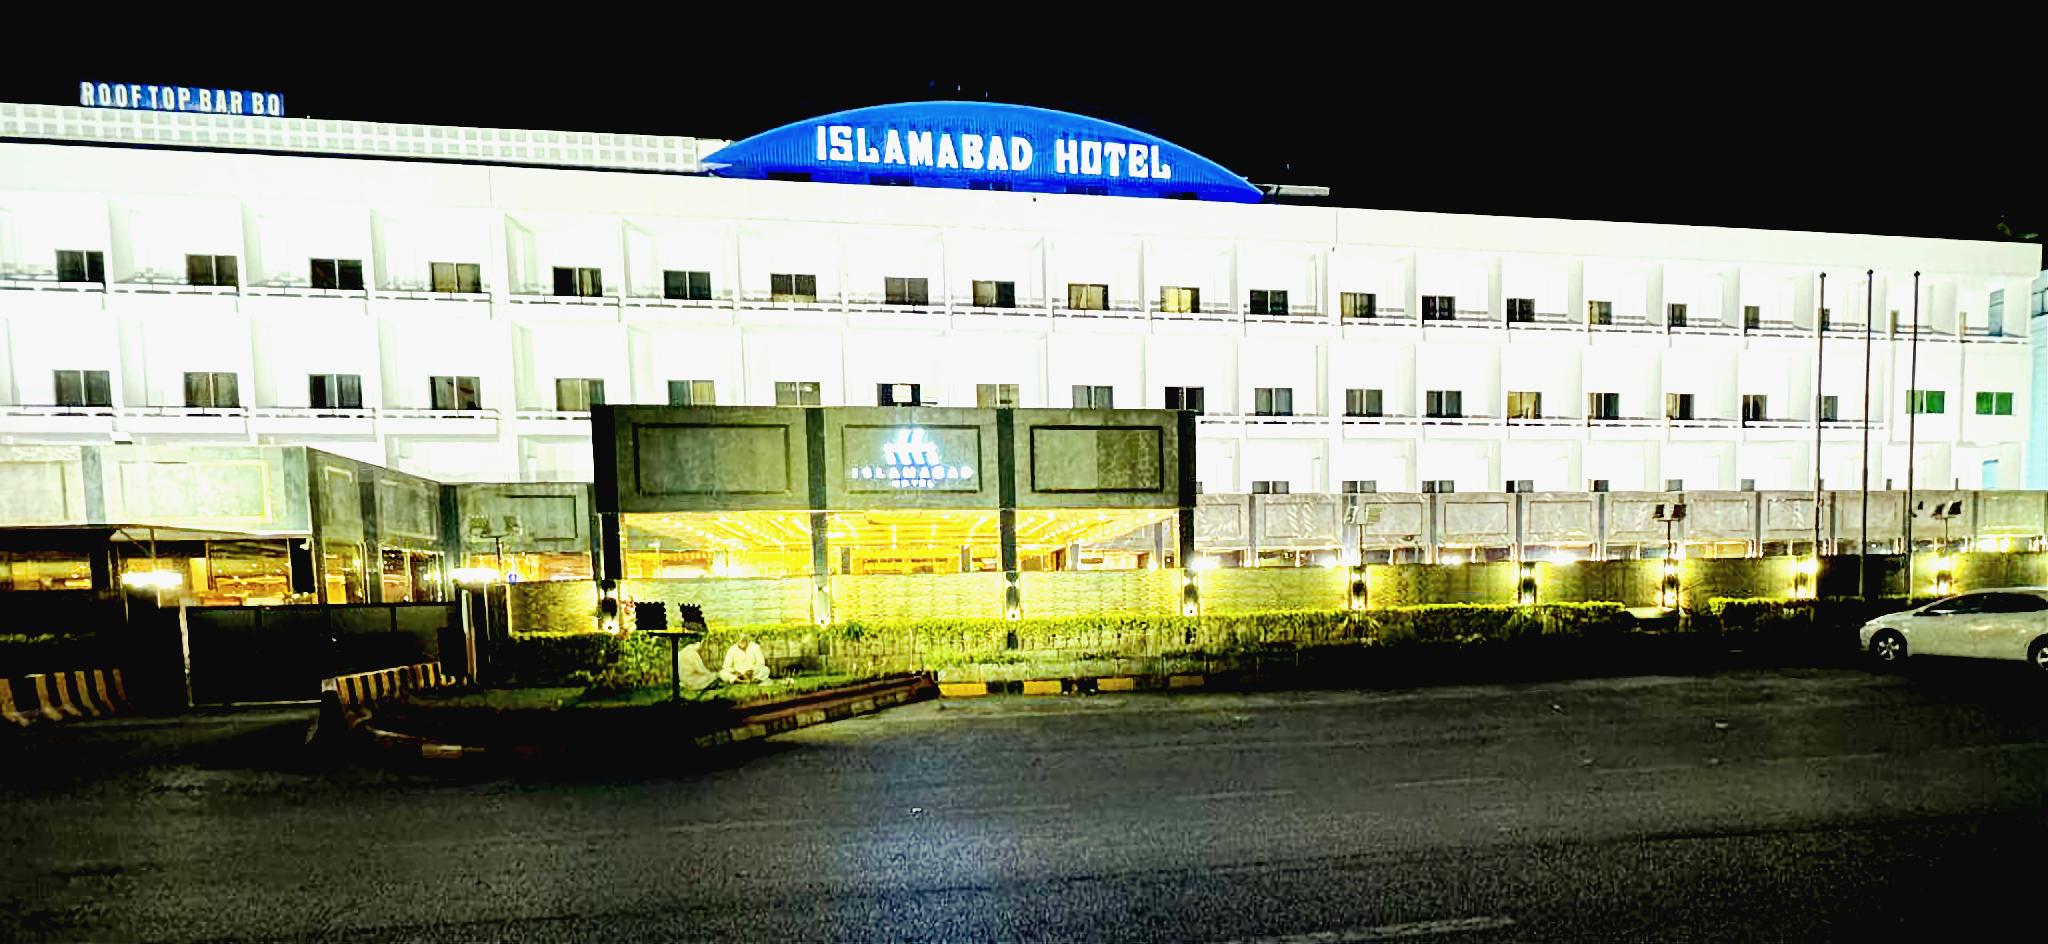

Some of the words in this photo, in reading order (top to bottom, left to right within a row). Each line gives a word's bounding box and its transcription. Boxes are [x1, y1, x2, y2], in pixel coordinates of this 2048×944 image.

[199, 88, 243, 114] BAR
[816, 125, 1034, 172] ISLAMABAD
[1055, 138, 1172, 180] HOTEL
